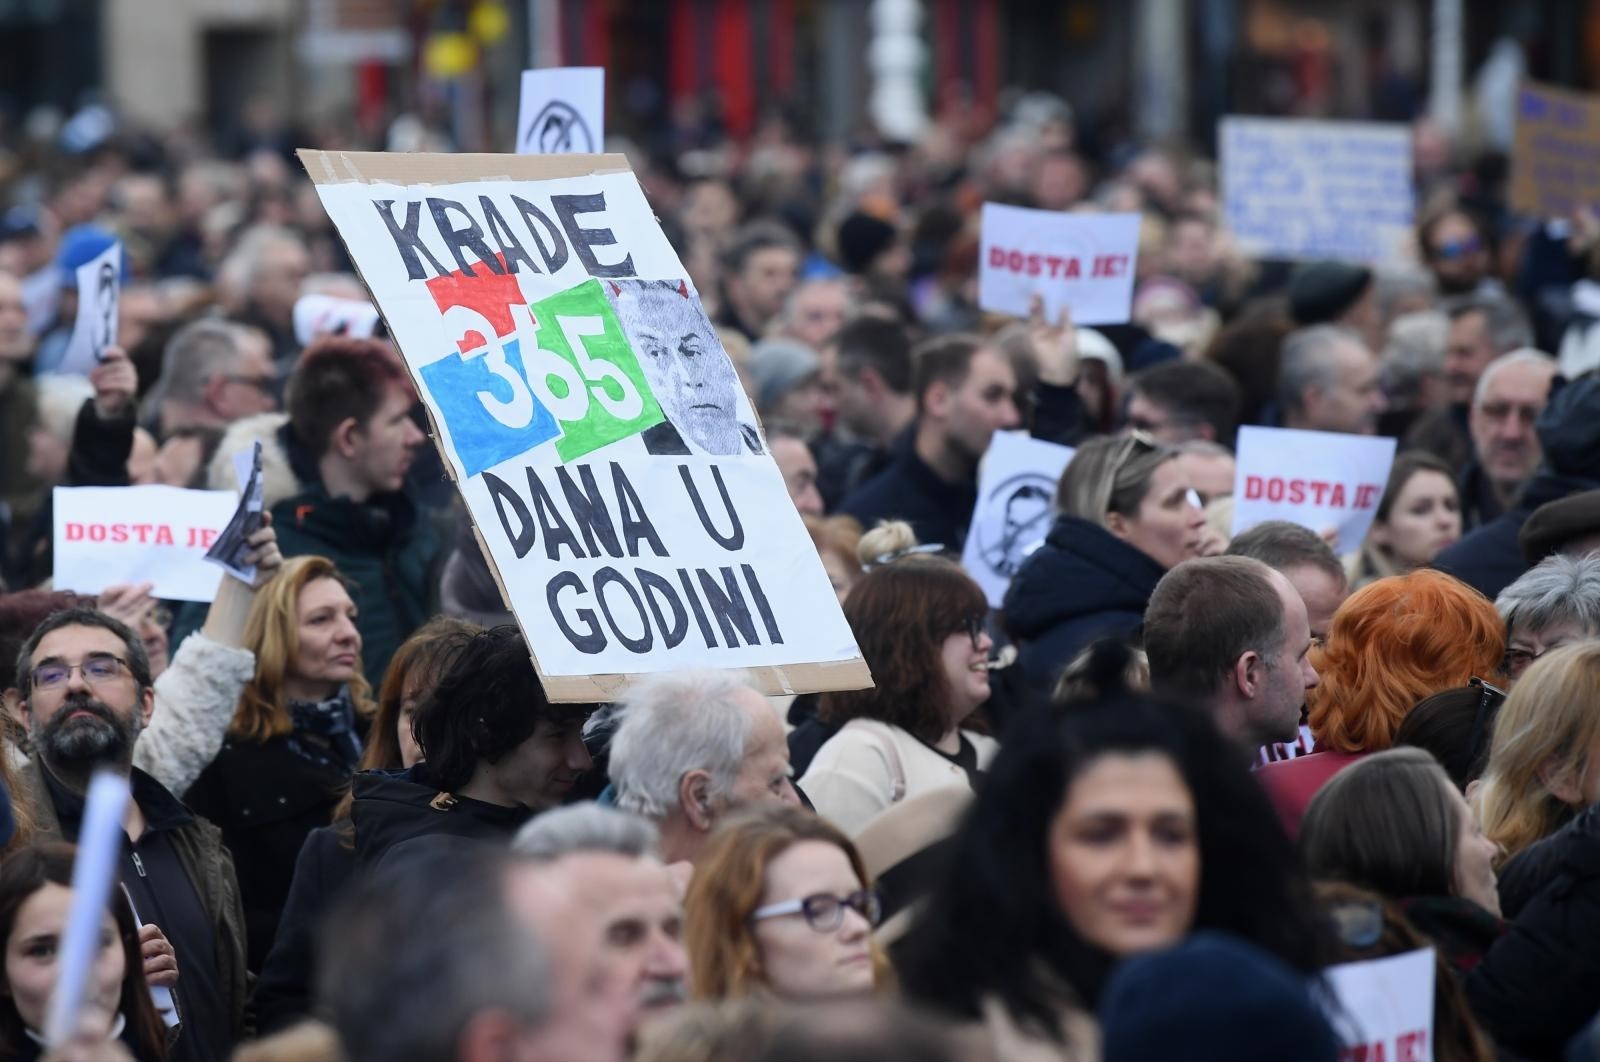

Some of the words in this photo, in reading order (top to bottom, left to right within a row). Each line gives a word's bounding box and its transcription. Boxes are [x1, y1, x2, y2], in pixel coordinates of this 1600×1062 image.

[371, 191, 638, 281] KRADE
[989, 247, 1081, 279] DOSTA
[442, 304, 644, 429] 365
[65, 523, 175, 546] DOSTA
[481, 461, 671, 561] DANA
[677, 464, 745, 551] U
[1245, 476, 1346, 509] DOSTA
[546, 565, 784, 654] GODINI
